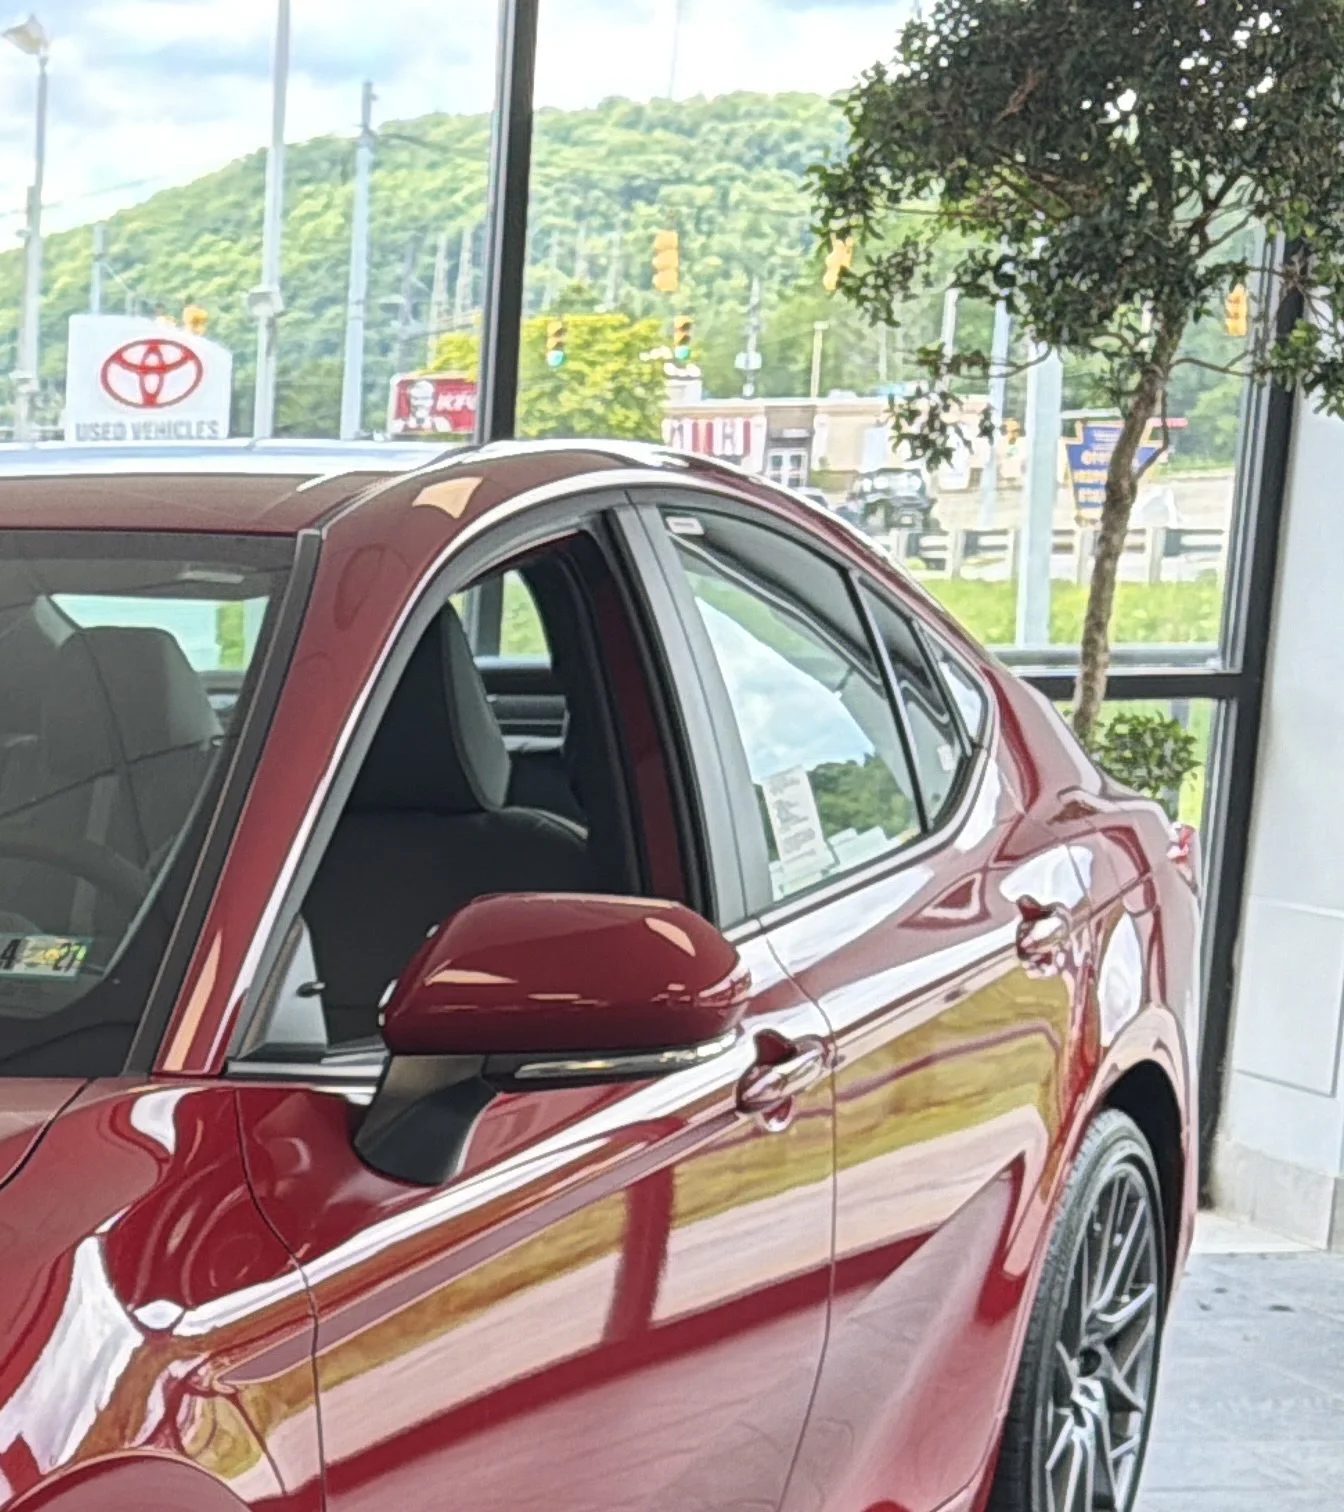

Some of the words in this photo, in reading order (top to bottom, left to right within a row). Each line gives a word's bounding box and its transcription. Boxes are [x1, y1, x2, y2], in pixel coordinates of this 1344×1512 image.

[74, 422, 127, 442] USED
[131, 419, 220, 441] VEHICLES
[0, 938, 22, 971] 4
